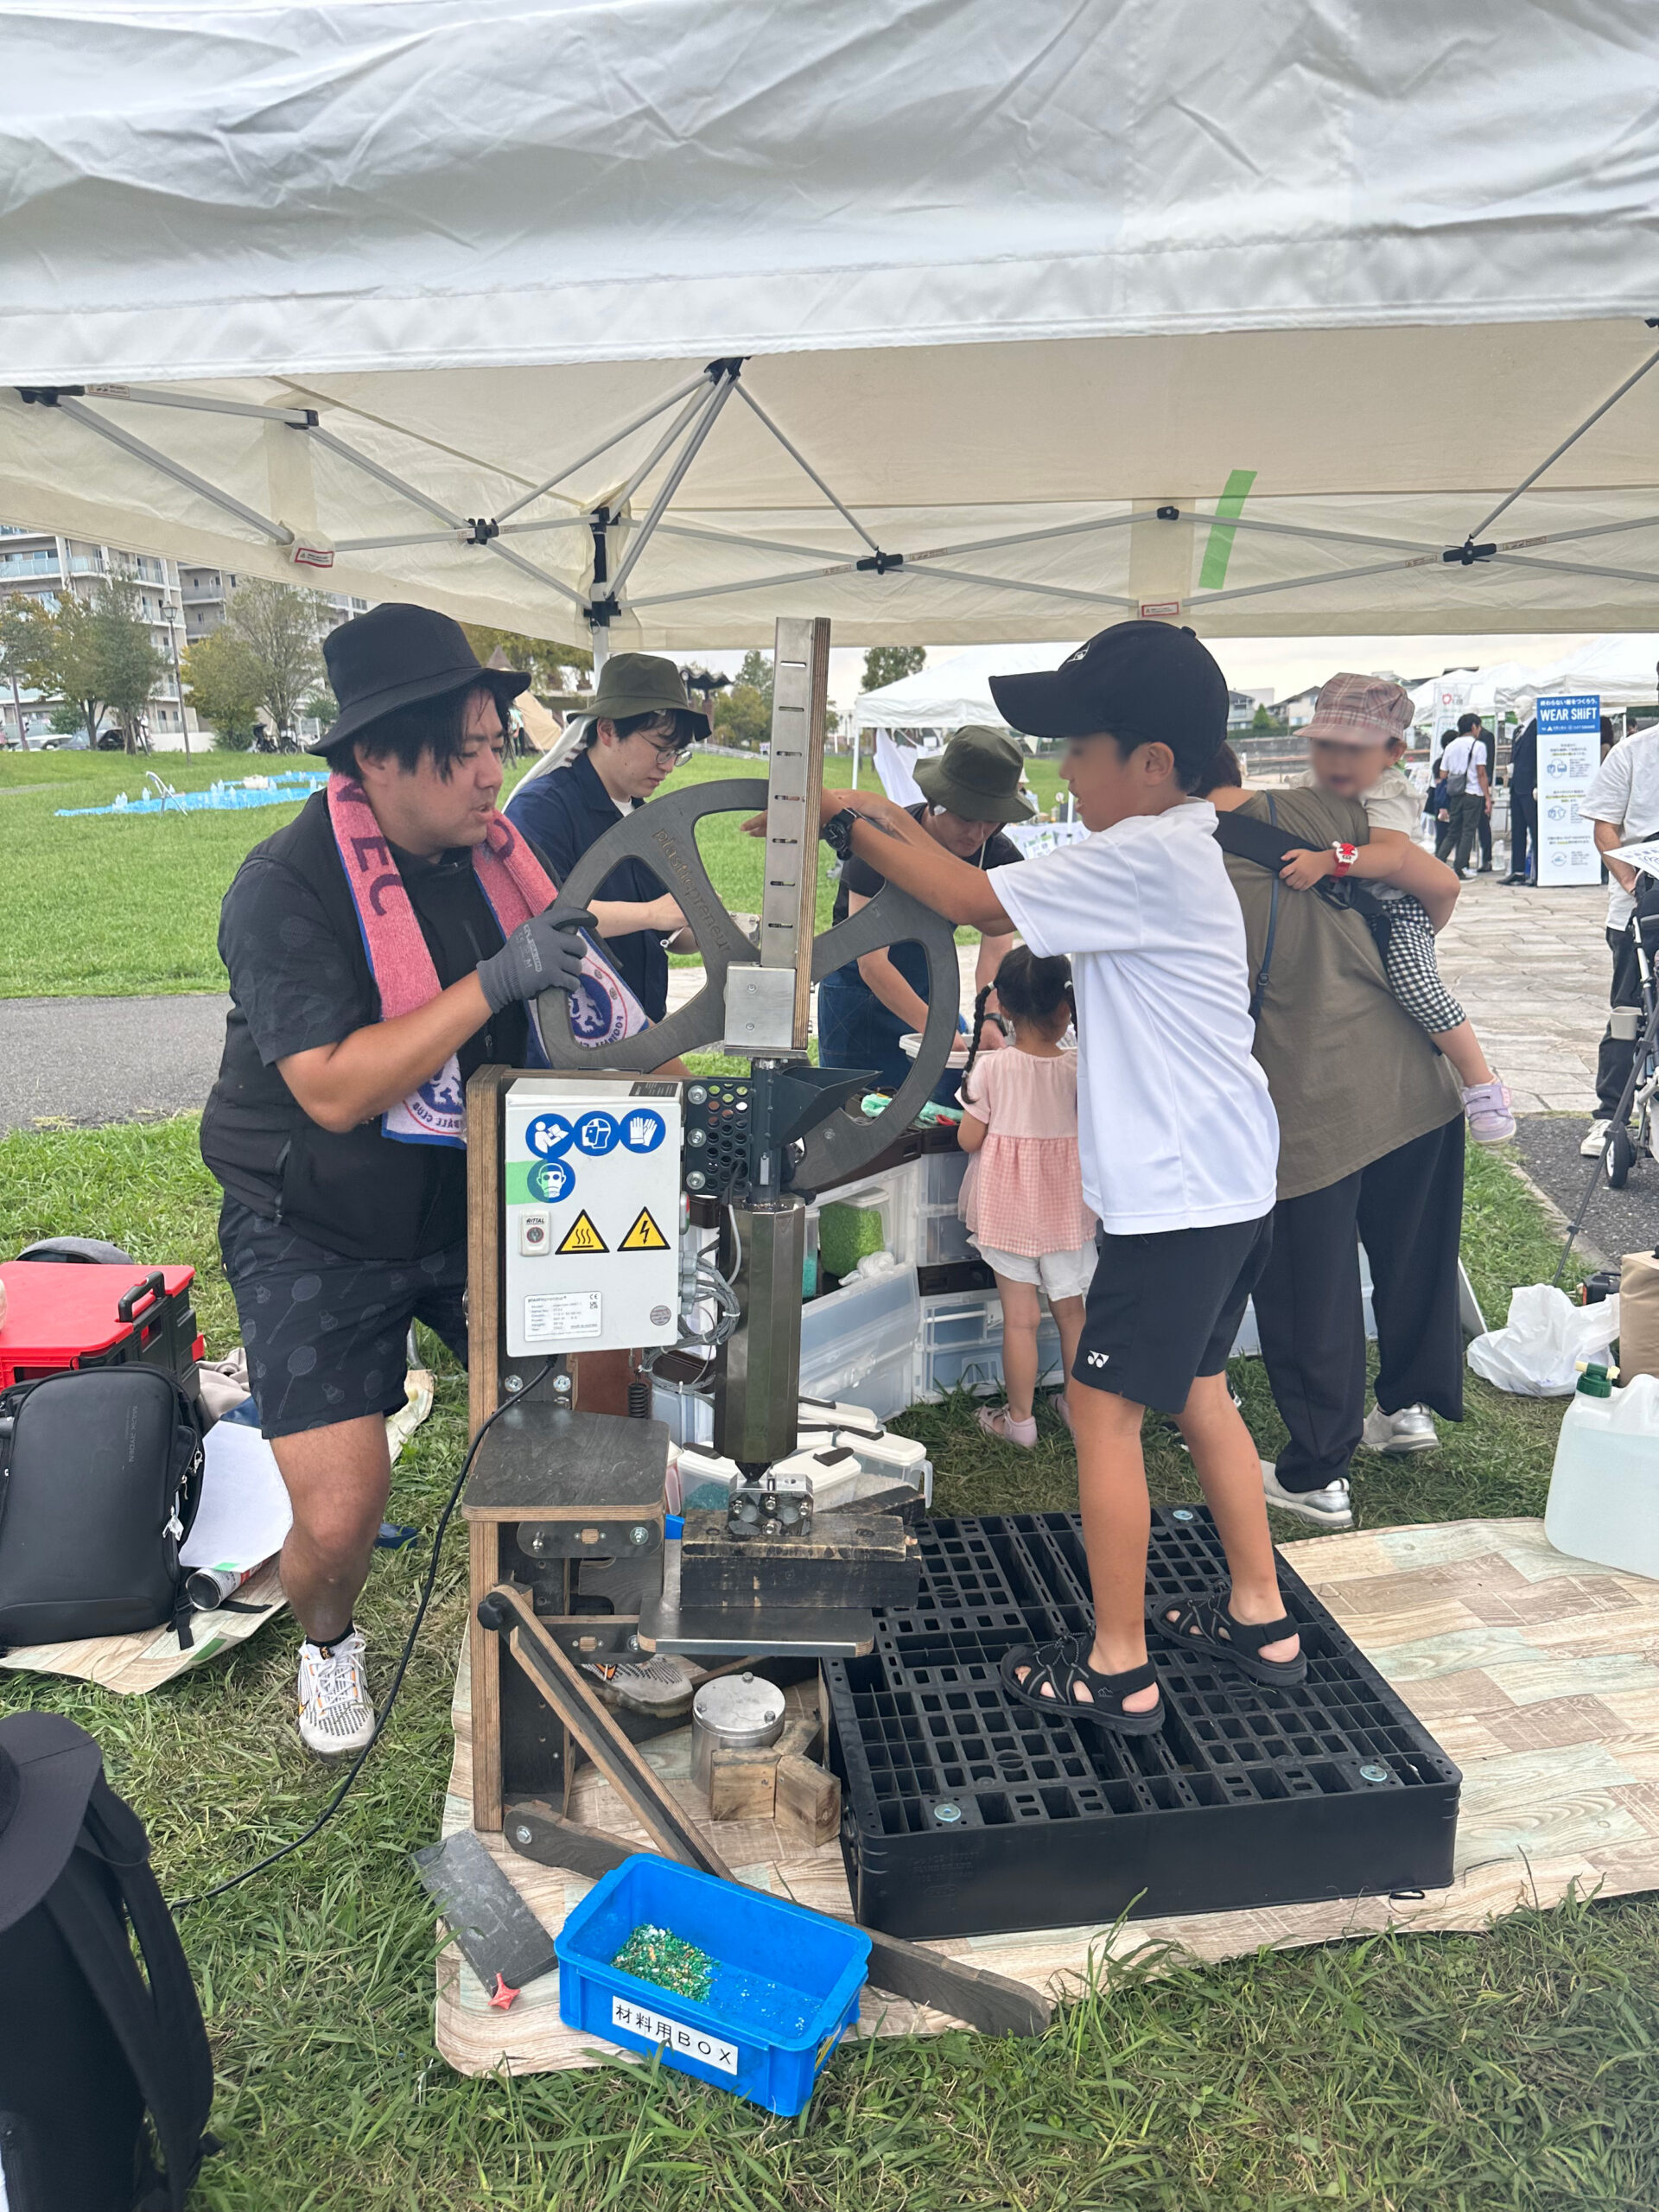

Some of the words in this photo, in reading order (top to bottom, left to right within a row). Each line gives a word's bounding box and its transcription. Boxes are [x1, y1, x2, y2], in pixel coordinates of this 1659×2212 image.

[1540, 709, 1568, 721] WEAR
[652, 828, 732, 950] plasticpreneur
[616, 2005, 731, 2064] 材料用BOX
